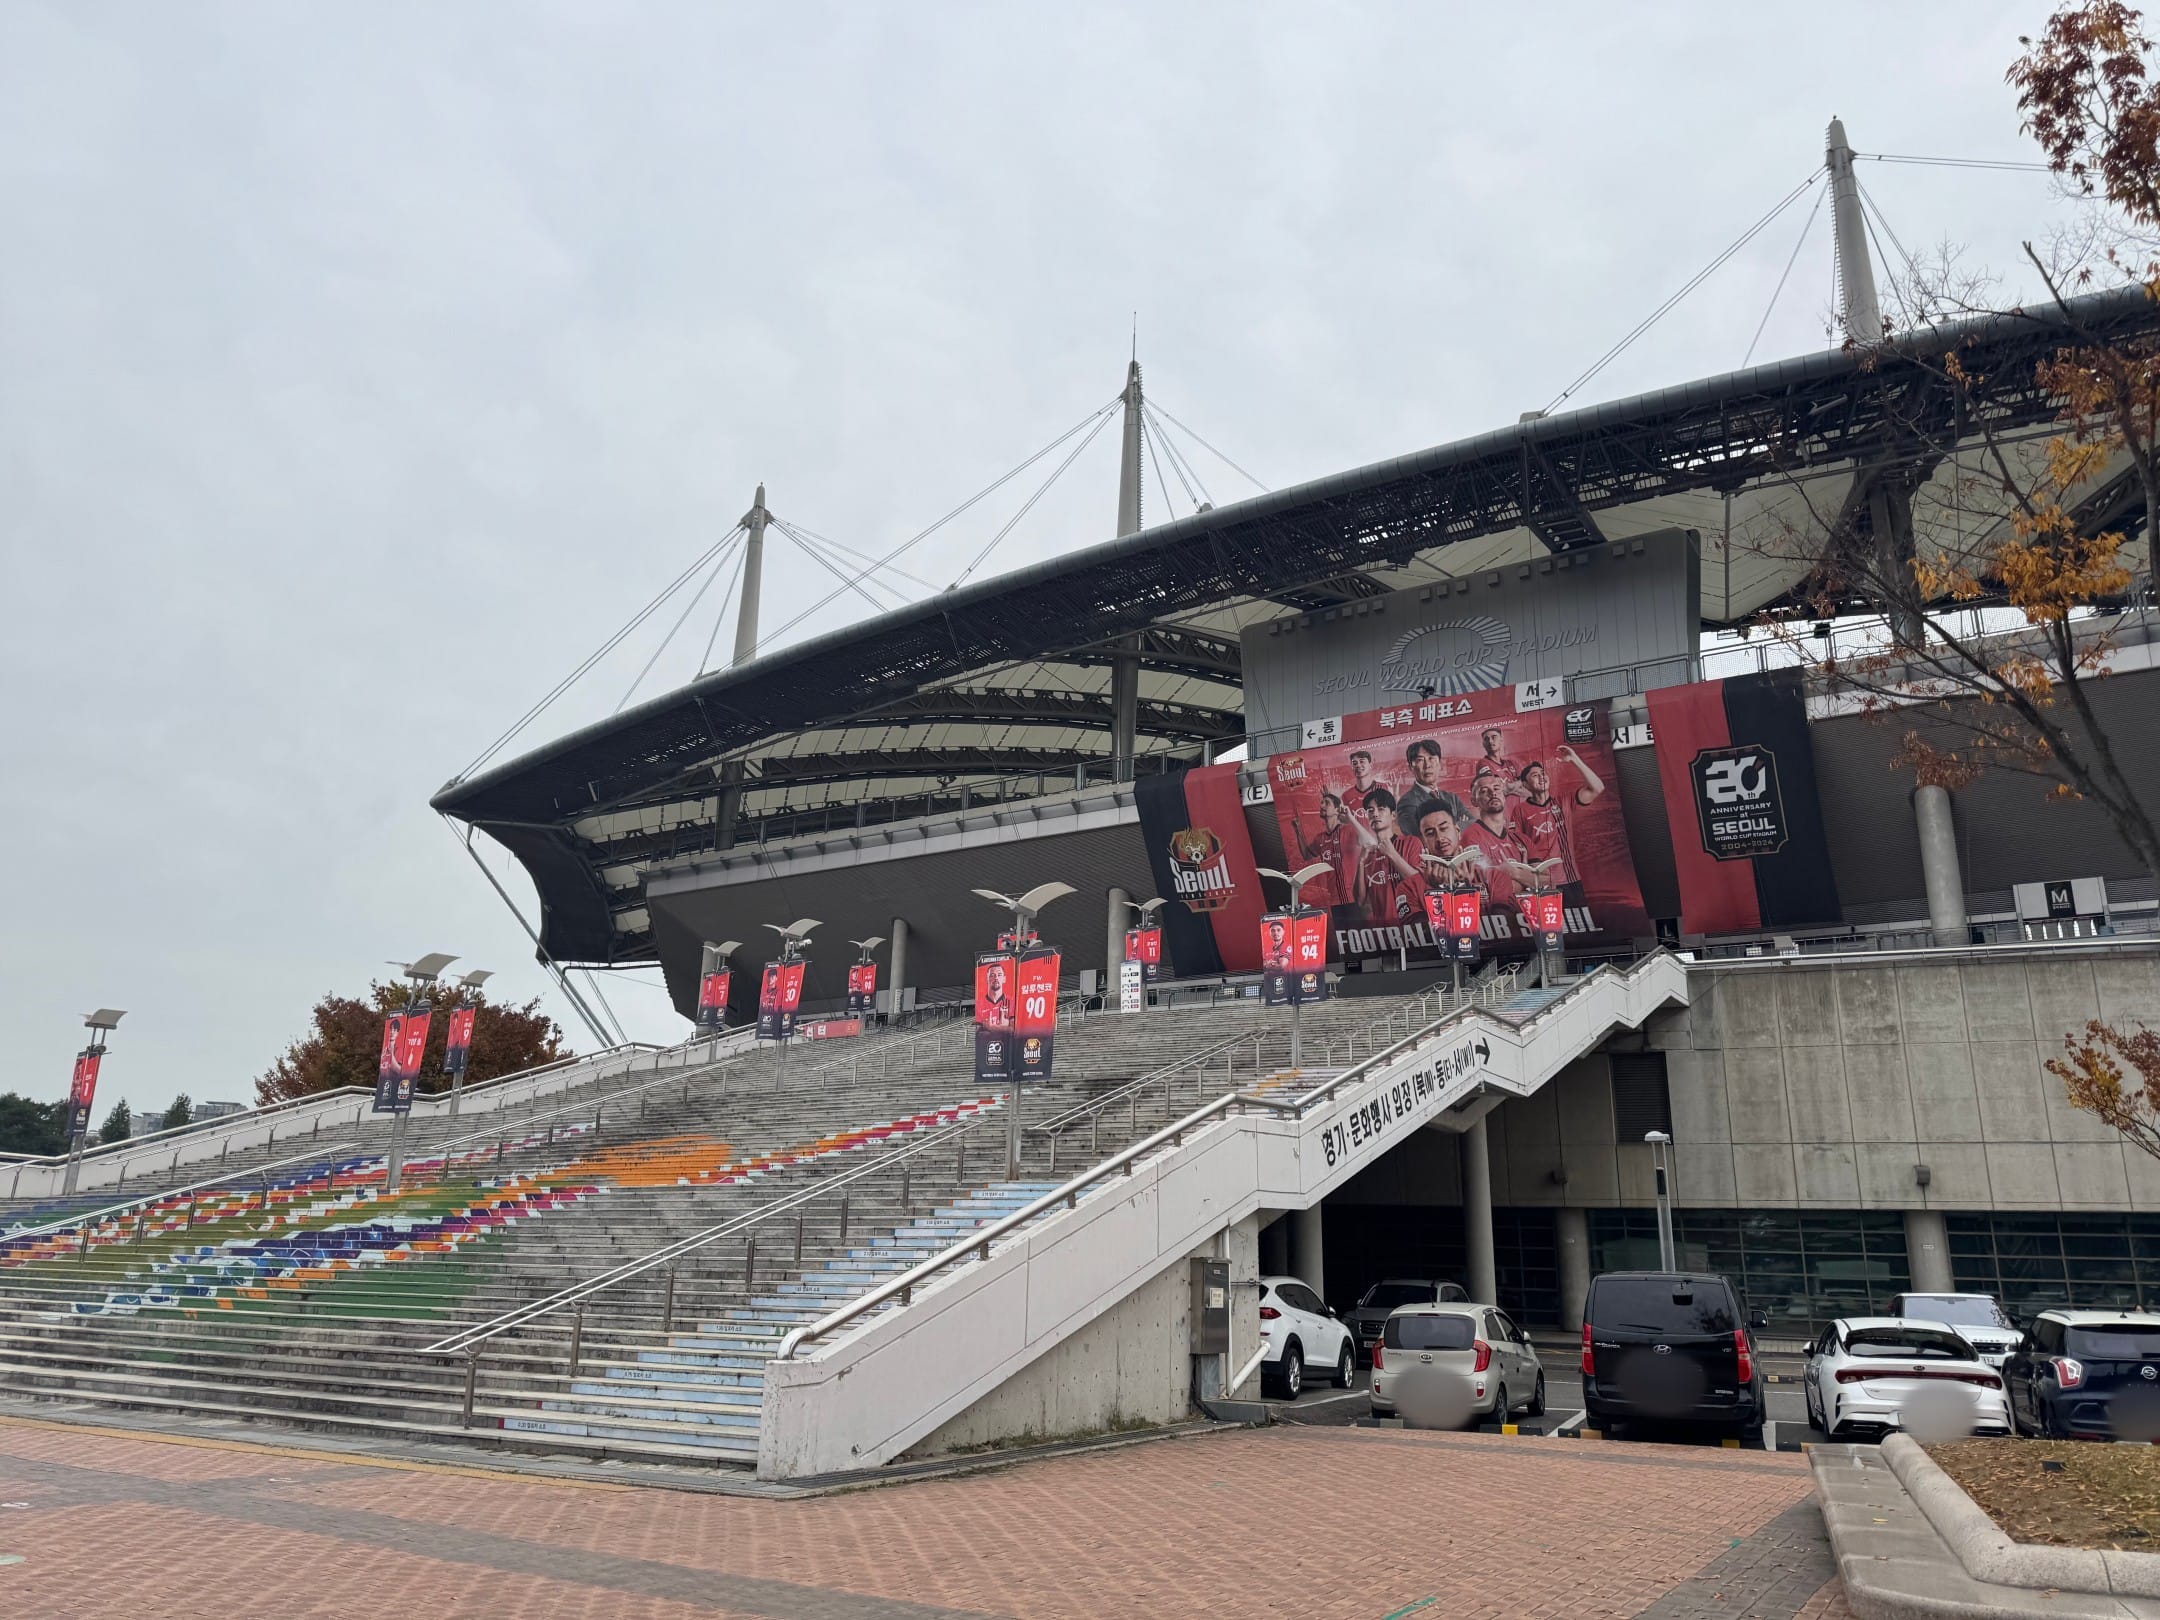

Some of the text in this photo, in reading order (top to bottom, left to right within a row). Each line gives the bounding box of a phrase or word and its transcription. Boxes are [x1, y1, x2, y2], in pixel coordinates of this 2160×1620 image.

[1313, 623, 1597, 696] SEOUL WORLD CUP STADIUM
[1526, 683, 1540, 697] 서
[1522, 698, 1545, 708] WEST
[1380, 698, 1473, 729] 북측 매표소
[1322, 721, 1334, 734] 동
[1567, 727, 1593, 735] SEOUL
[1318, 734, 1336, 743] EAST
[1276, 762, 1308, 782] Seoul
[1710, 801, 1772, 815] ANNIVERSARY
[1712, 817, 1776, 836] SEOUL
[1169, 853, 1236, 893] Seoul
[2051, 890, 2068, 904] M
[1459, 916, 1472, 929] 19
[1545, 913, 1557, 924] 32
[1149, 947, 1156, 957] 11
[1302, 944, 1319, 960] 94
[720, 990, 725, 1001] 7
[1026, 996, 1046, 1019] 90
[464, 1029, 470, 1041] 9
[1391, 1079, 1413, 1119] 입장
